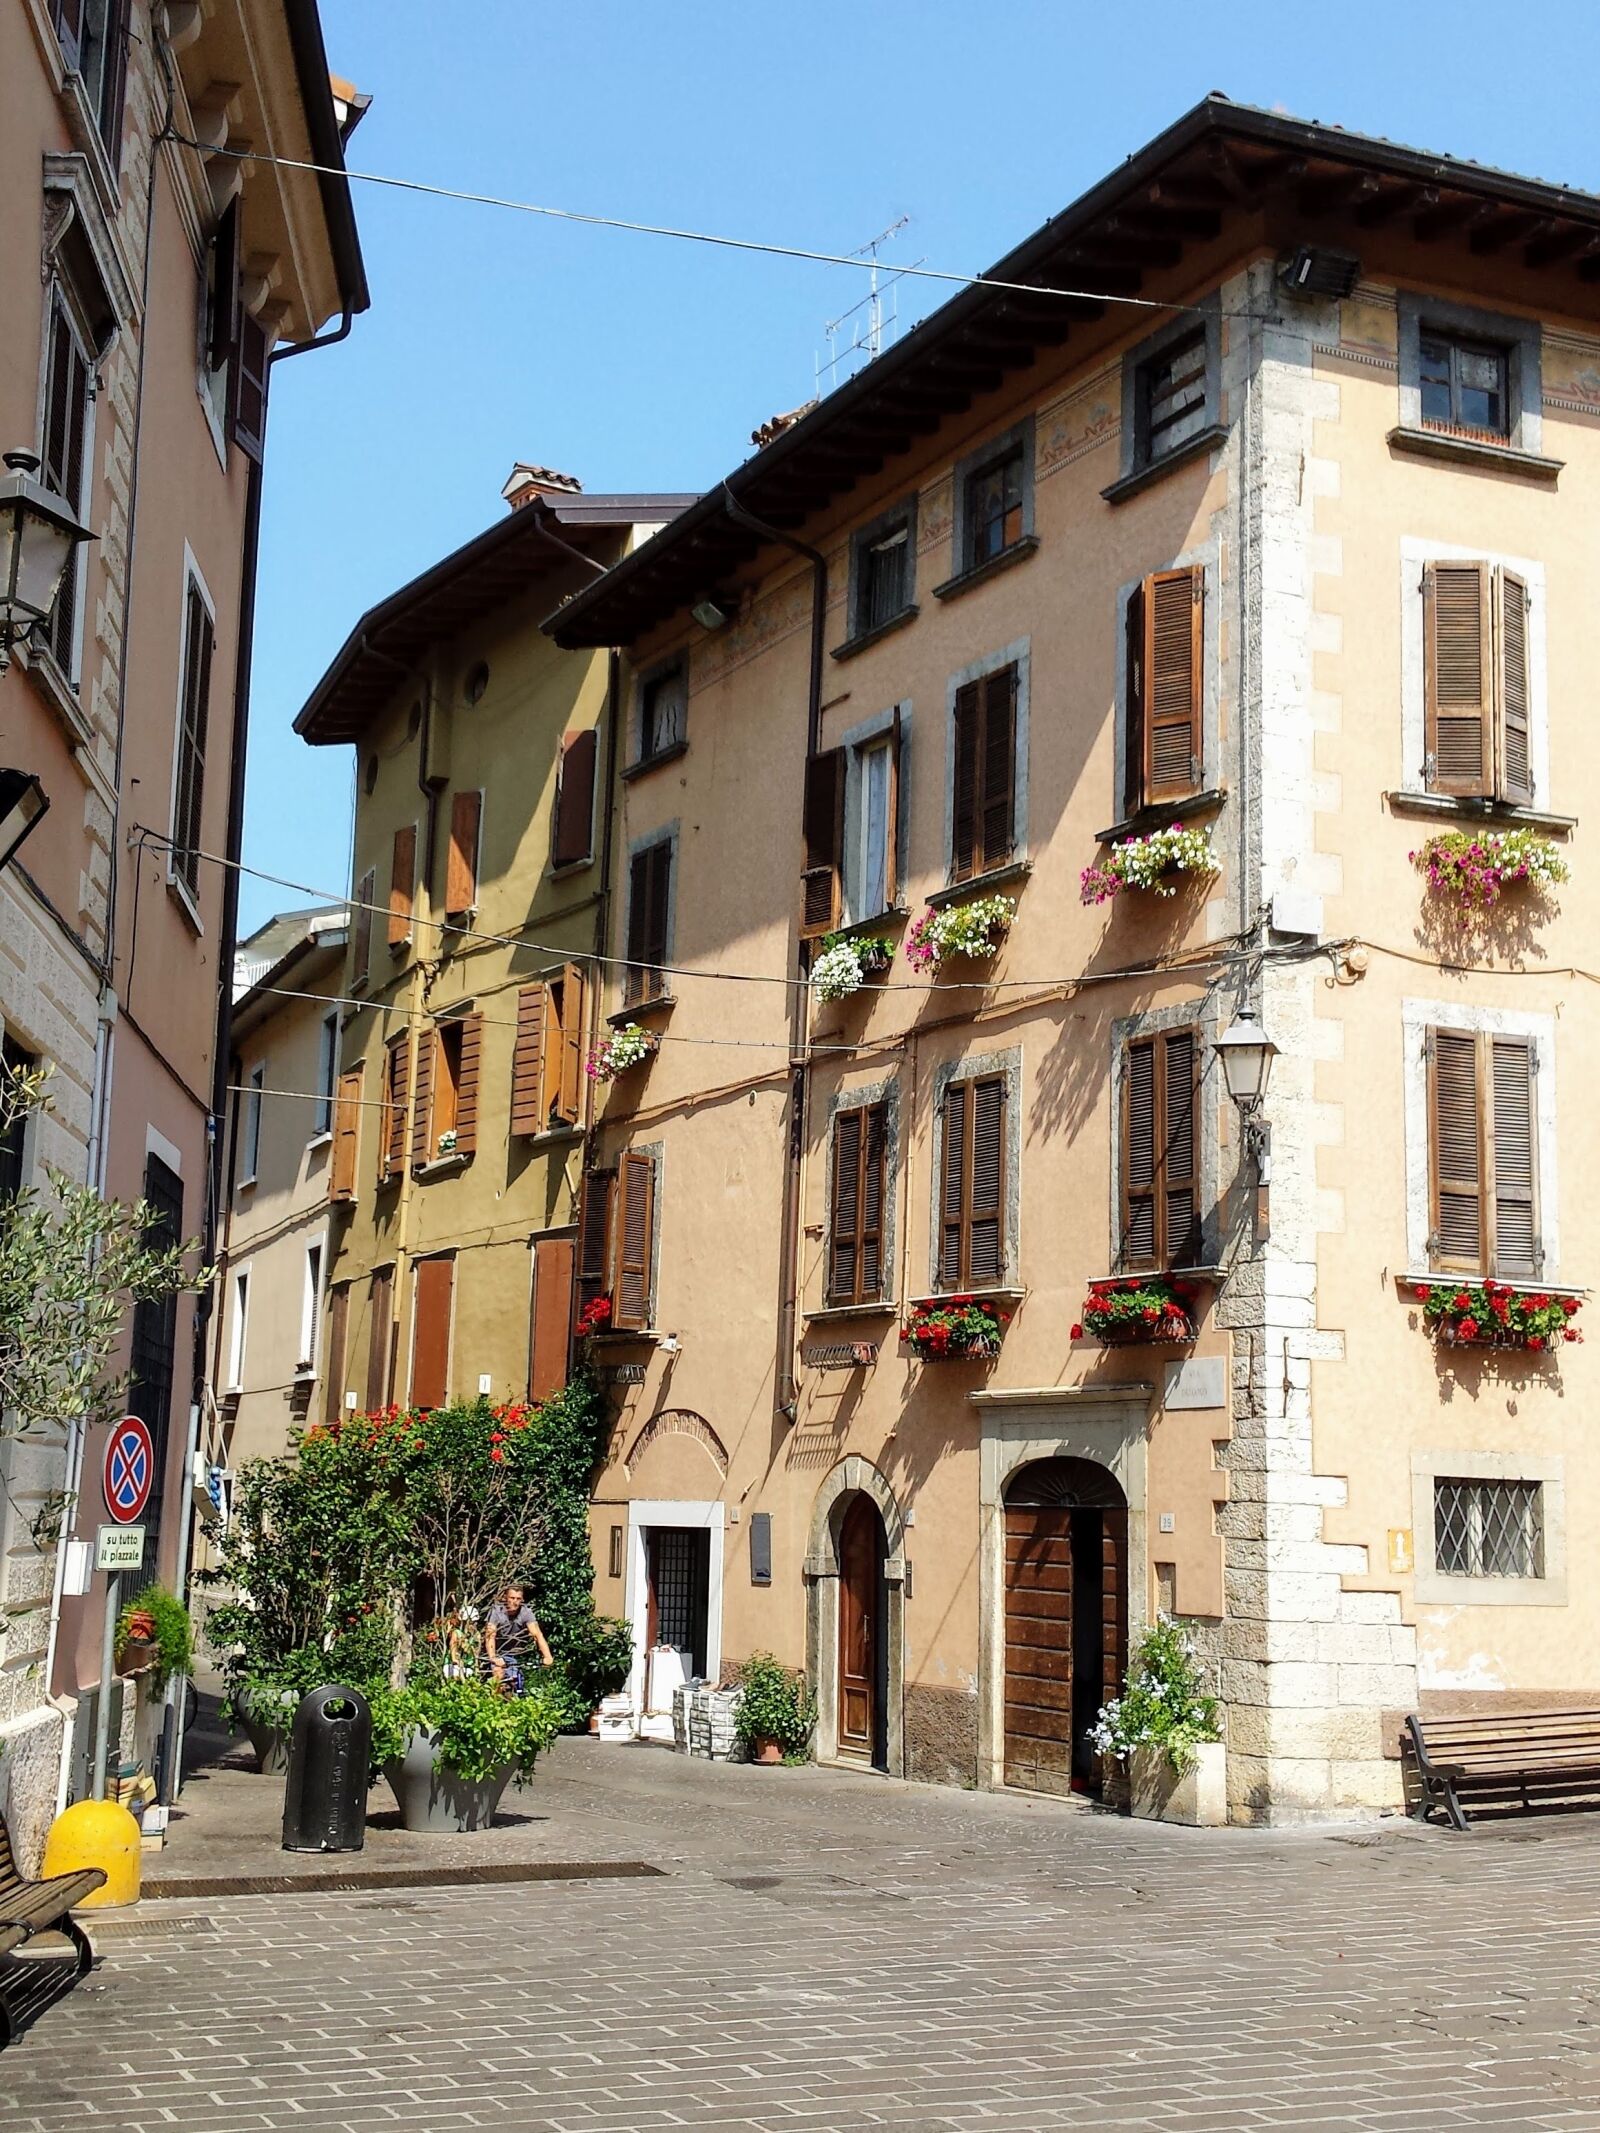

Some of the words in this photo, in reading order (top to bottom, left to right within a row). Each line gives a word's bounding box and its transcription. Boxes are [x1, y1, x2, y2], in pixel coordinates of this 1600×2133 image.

[106, 1536, 117, 1545] su
[119, 1534, 138, 1545] tutto
[101, 1549, 107, 1561] il
[110, 1549, 139, 1563] piazzale
